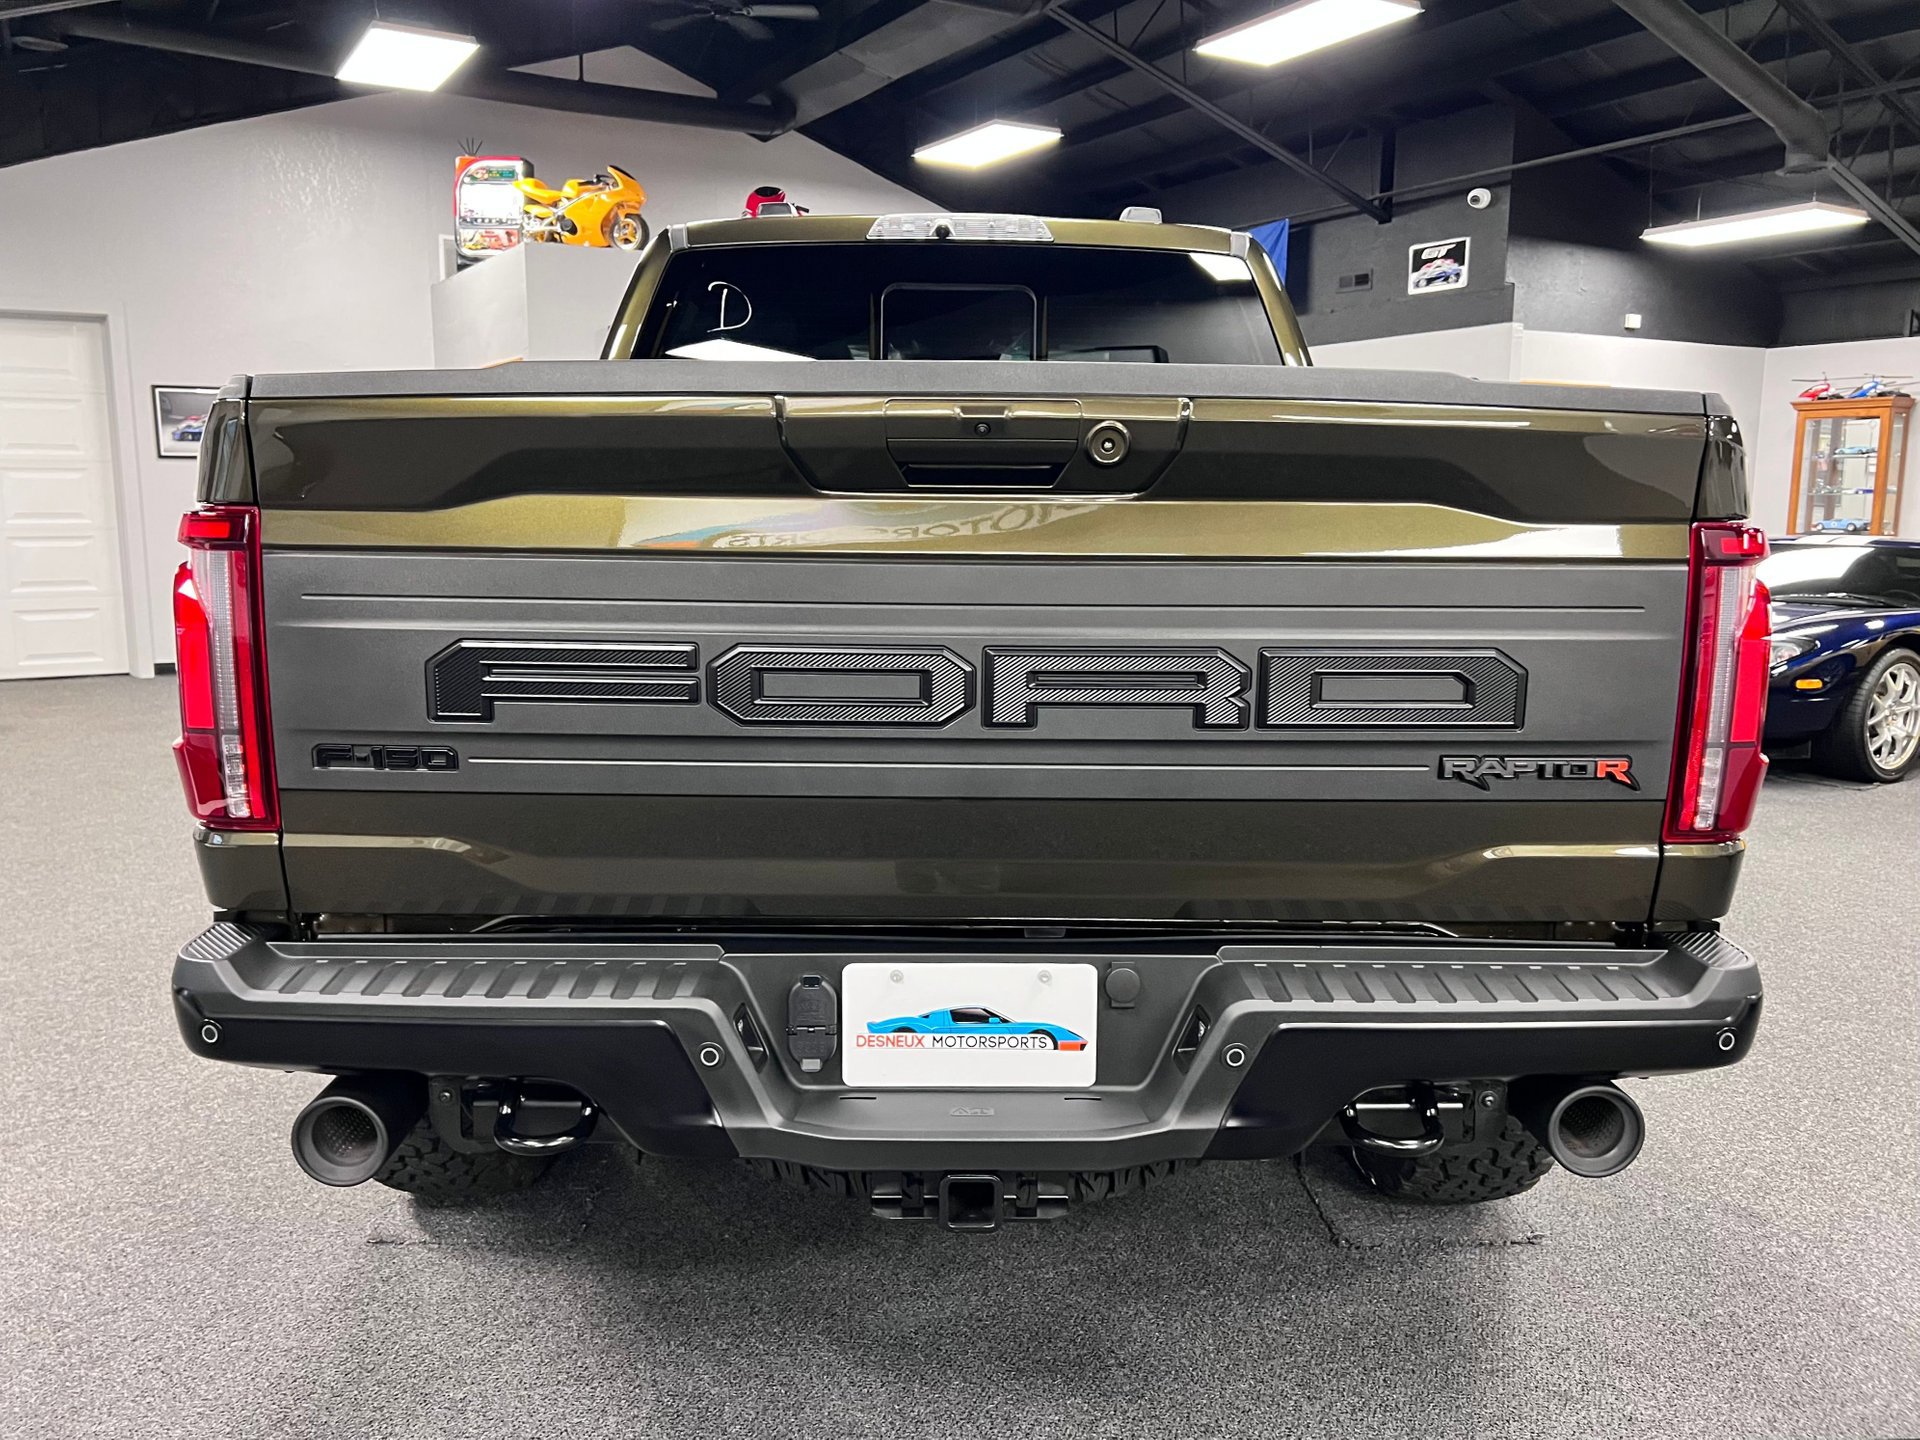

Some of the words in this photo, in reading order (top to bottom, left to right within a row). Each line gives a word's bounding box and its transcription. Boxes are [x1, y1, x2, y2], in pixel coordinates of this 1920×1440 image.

[1421, 244, 1457, 260] GT
[706, 280, 753, 333] D
[425, 638, 1529, 731] FORD
[312, 744, 459, 771] F-150
[1437, 755, 1641, 791] RAPTOR
[856, 1034, 925, 1048] DESNEUX
[931, 1036, 1048, 1049] MOTORSPORTS
